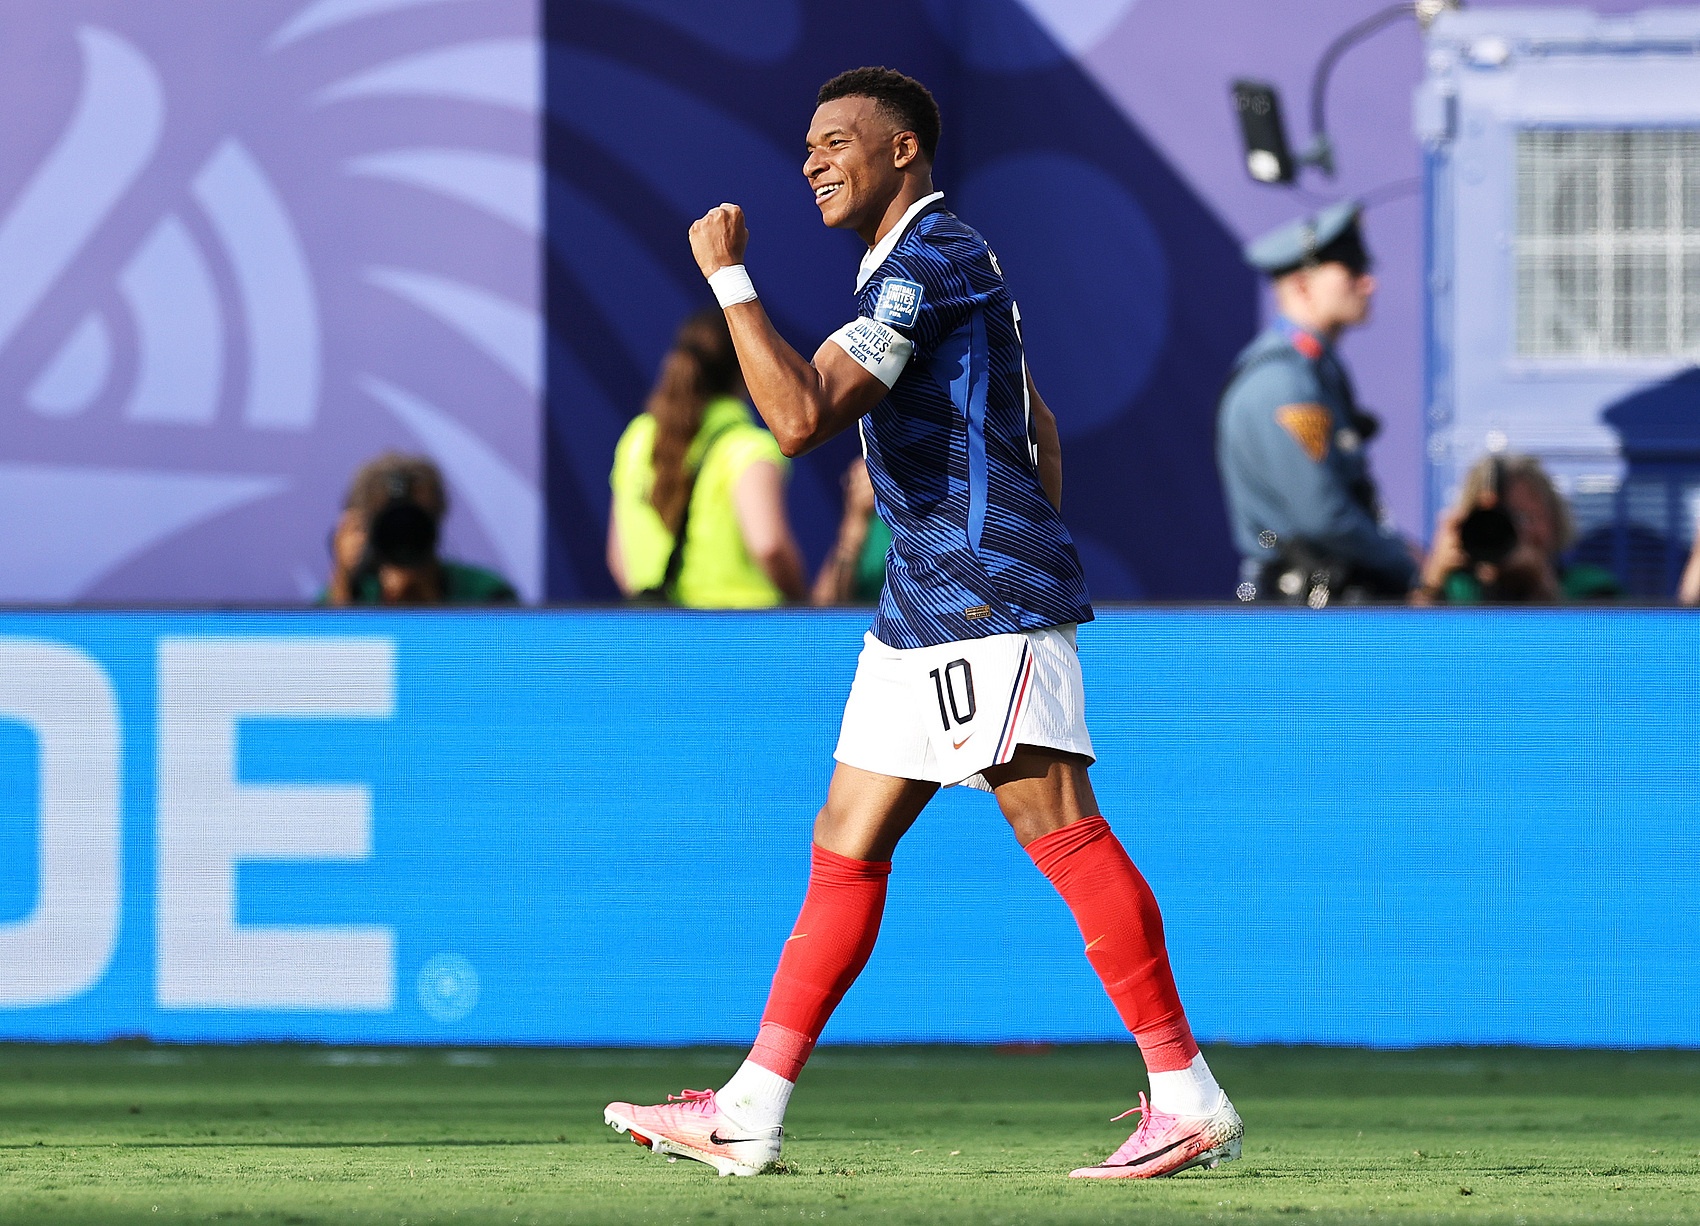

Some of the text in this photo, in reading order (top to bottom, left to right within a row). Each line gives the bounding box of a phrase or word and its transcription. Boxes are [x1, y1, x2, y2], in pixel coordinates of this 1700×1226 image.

[886, 291, 915, 306] UNITES
[854, 323, 889, 353] UNITES
[865, 318, 894, 344] FOOTBALL
[845, 330, 885, 365] the World
[929, 657, 977, 732] 10
